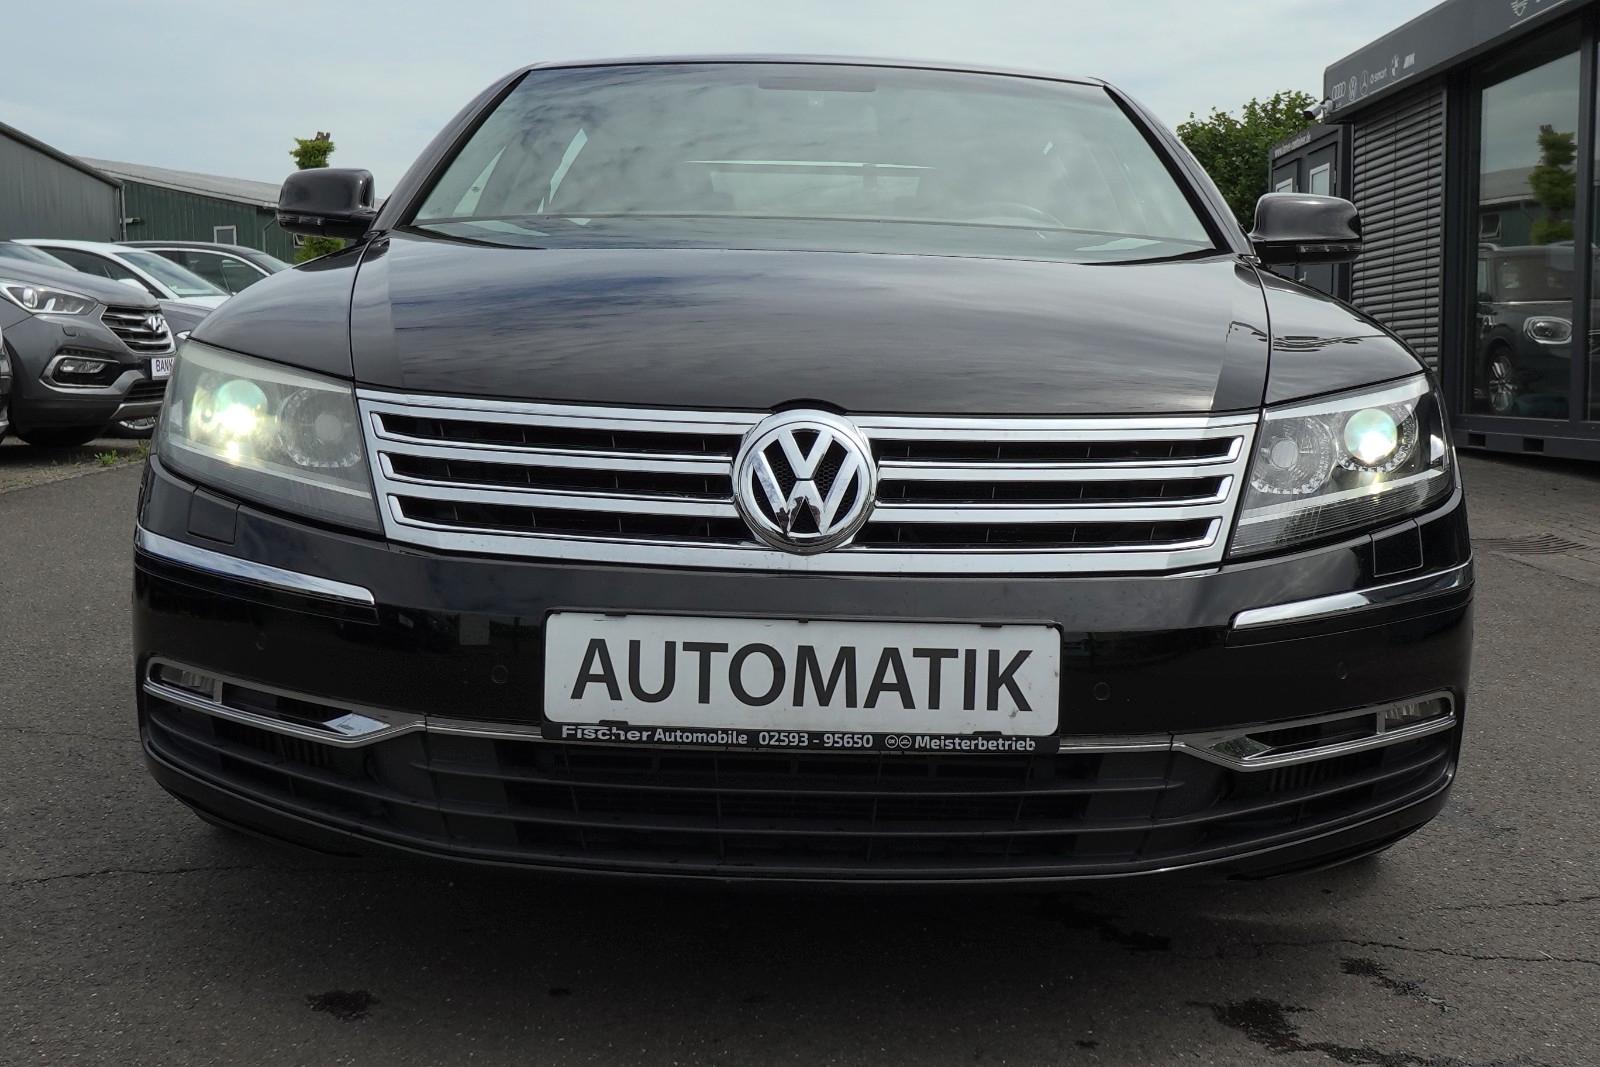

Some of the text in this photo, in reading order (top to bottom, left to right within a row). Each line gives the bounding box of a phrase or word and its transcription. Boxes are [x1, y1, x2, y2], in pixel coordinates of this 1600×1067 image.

[569, 637, 1033, 712] AUTOMATIK
[561, 724, 651, 742] Fischer
[653, 728, 748, 745] Automobile
[758, 731, 809, 747] 02593
[823, 733, 873, 748] 95650
[915, 735, 1036, 751] Meisterbetrieb
